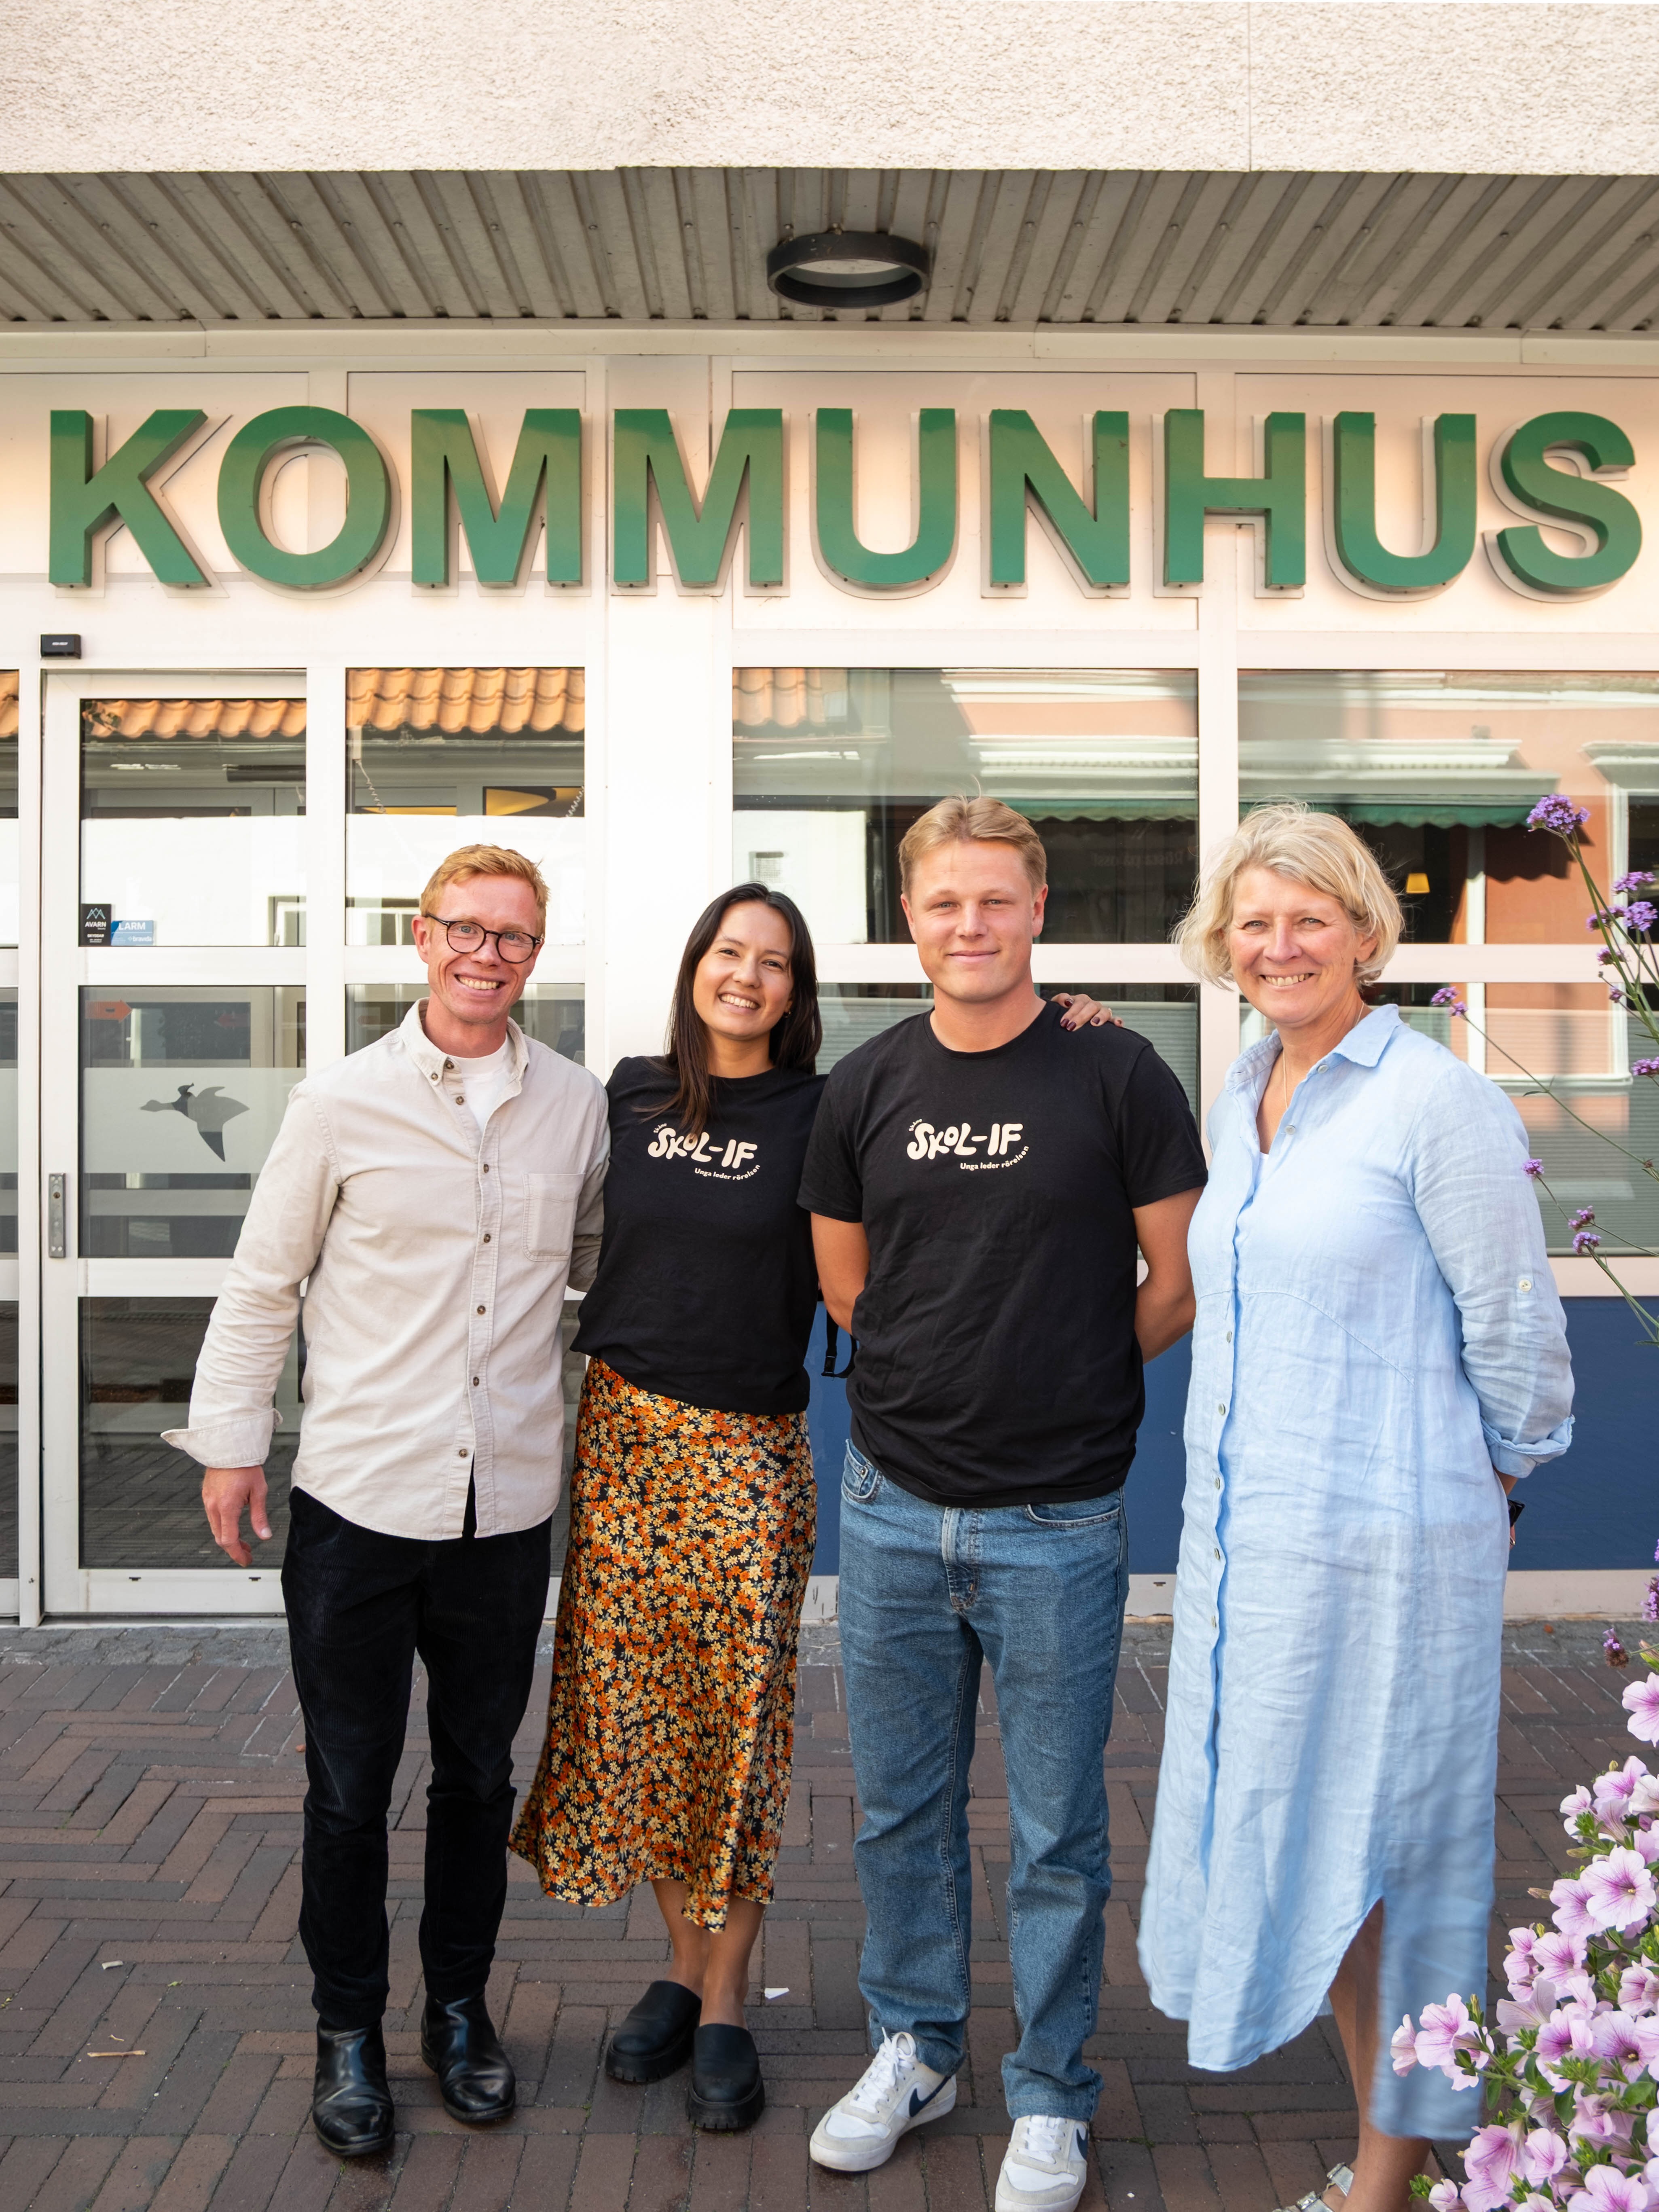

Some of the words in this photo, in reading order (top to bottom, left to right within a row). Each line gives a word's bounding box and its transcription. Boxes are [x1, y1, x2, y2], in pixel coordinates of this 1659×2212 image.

[49, 405, 1643, 591] KOMMUNHUS
[118, 922, 146, 930] LARM
[960, 1162, 979, 1171] Unga
[1001, 1146, 1029, 1168] rörelsen
[694, 1168, 712, 1177] Unga
[713, 1171, 732, 1180] leder
[732, 1164, 761, 1180] rörelsen
